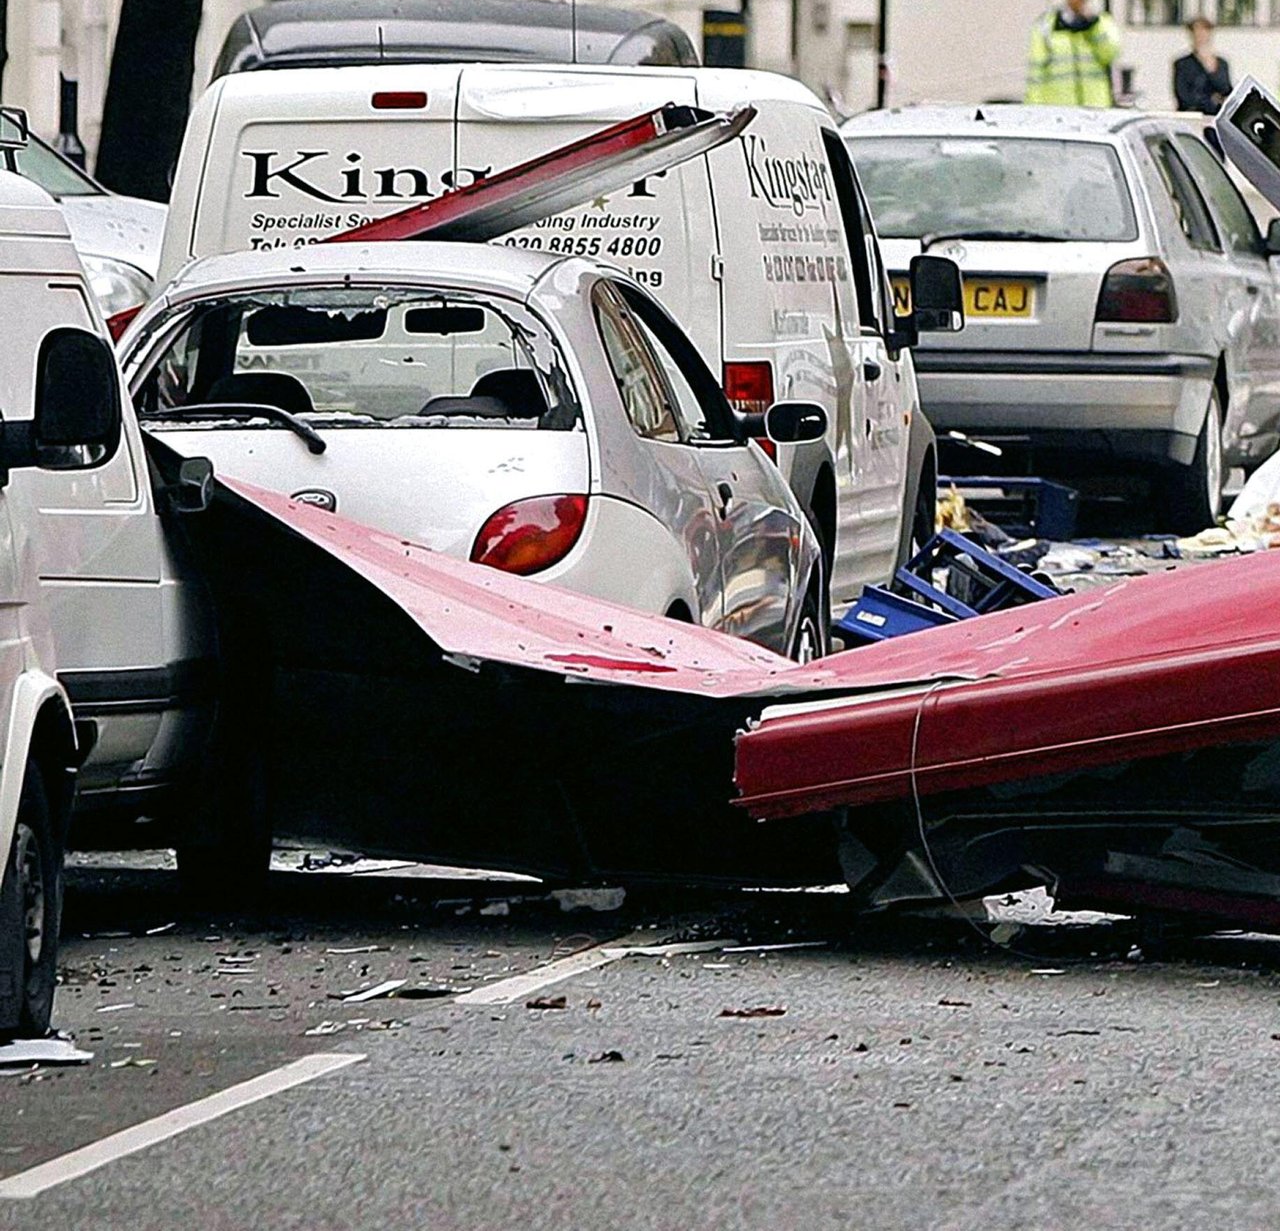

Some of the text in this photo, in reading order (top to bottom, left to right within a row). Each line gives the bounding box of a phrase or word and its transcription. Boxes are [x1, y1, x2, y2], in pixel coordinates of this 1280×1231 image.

[242, 152, 668, 204] Kingr
[740, 135, 831, 216] Kingstar
[251, 214, 341, 231] Specialist
[581, 214, 661, 231] Industry
[607, 238, 662, 256] 4800
[974, 286, 1028, 312] CAJ
